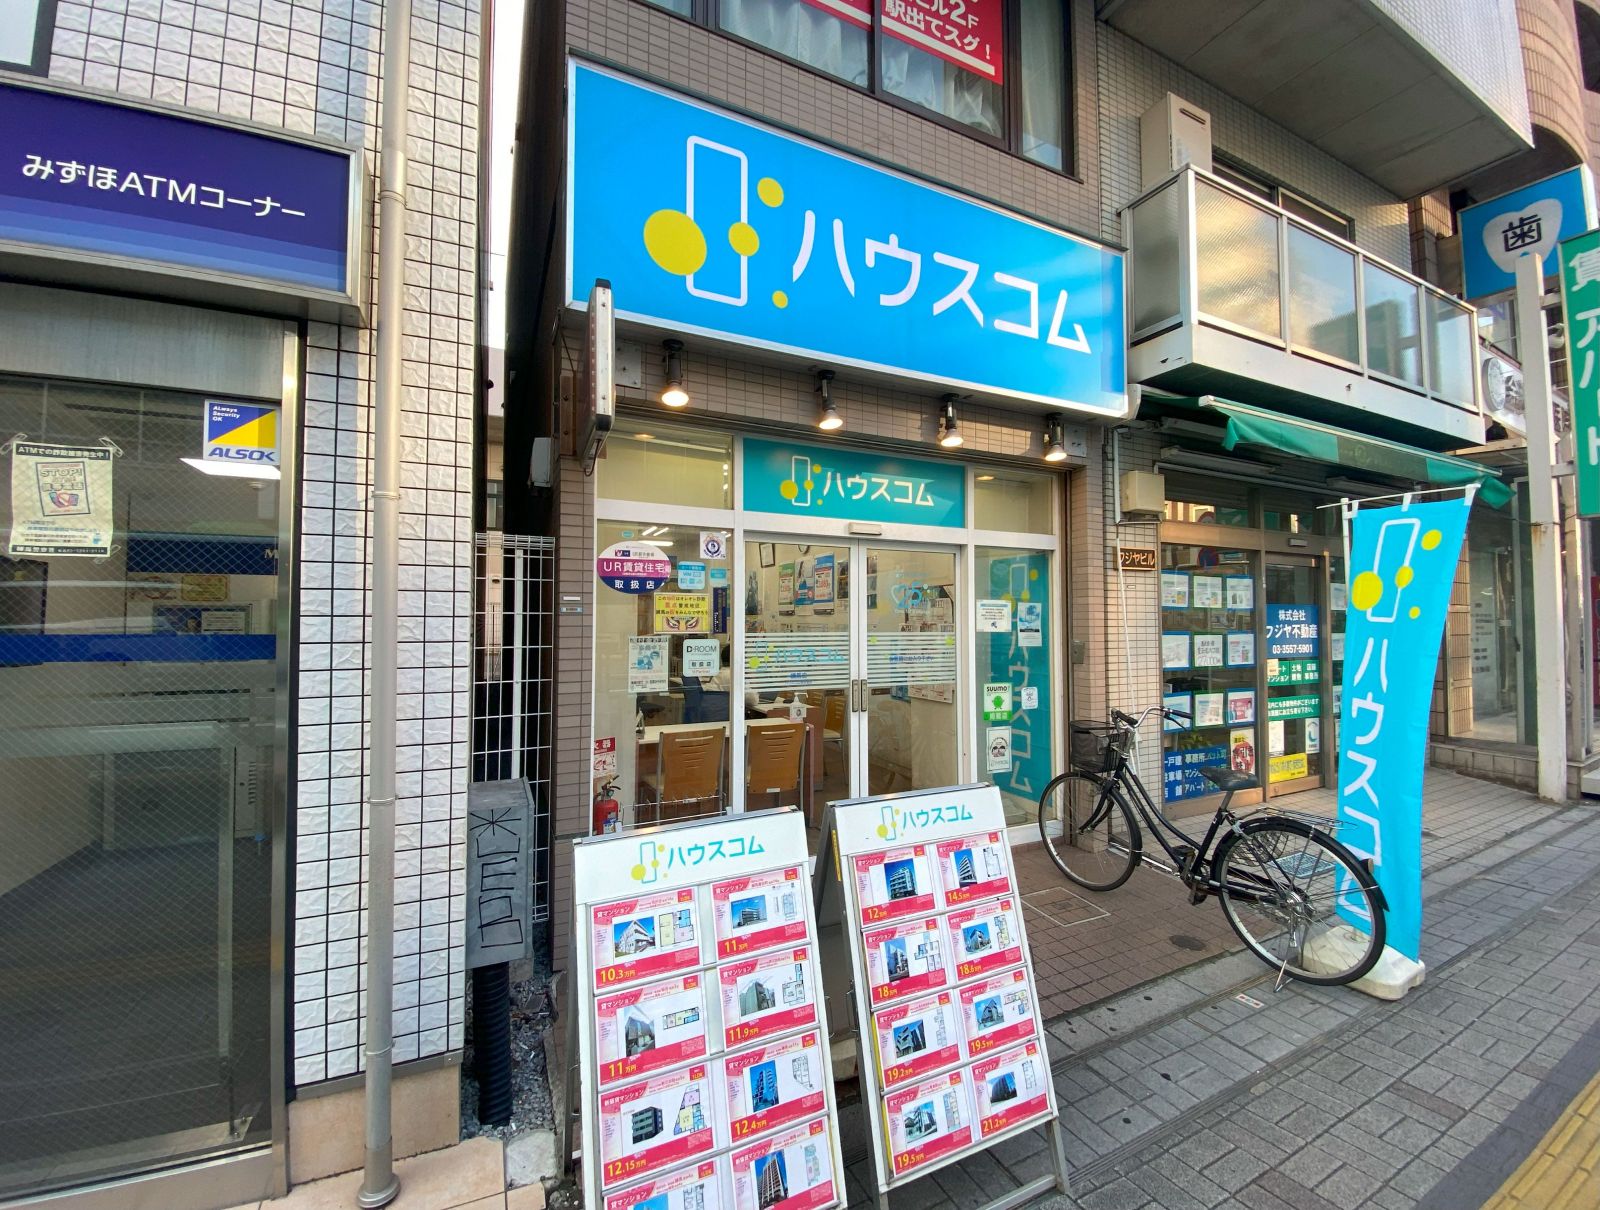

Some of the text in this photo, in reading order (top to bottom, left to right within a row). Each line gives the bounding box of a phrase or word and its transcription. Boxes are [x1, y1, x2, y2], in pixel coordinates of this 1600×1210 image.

[22, 153, 306, 218] みずほATMコーナー
[1502, 213, 1542, 252] 歯
[792, 209, 1092, 355] ハウスコム
[208, 447, 275, 462] ALSOK
[823, 471, 934, 507] ハウスコム
[603, 561, 665, 575] UR賃貸住宅
[614, 579, 655, 589] 取扱店
[1278, 609, 1307, 621] 株式会社
[1265, 624, 1318, 639] フジヤ不動産
[1272, 644, 1313, 655] 03-3557-5901
[1337, 637, 1388, 923] ハウスコム
[902, 805, 973, 830] ハウスコム
[667, 835, 766, 869] ハウスコム
[600, 967, 637, 985] 10.3万円
[609, 1061, 637, 1078] 11万円
[735, 1119, 767, 1136] 12.4万円
[608, 1159, 647, 1178] 12.15万円
